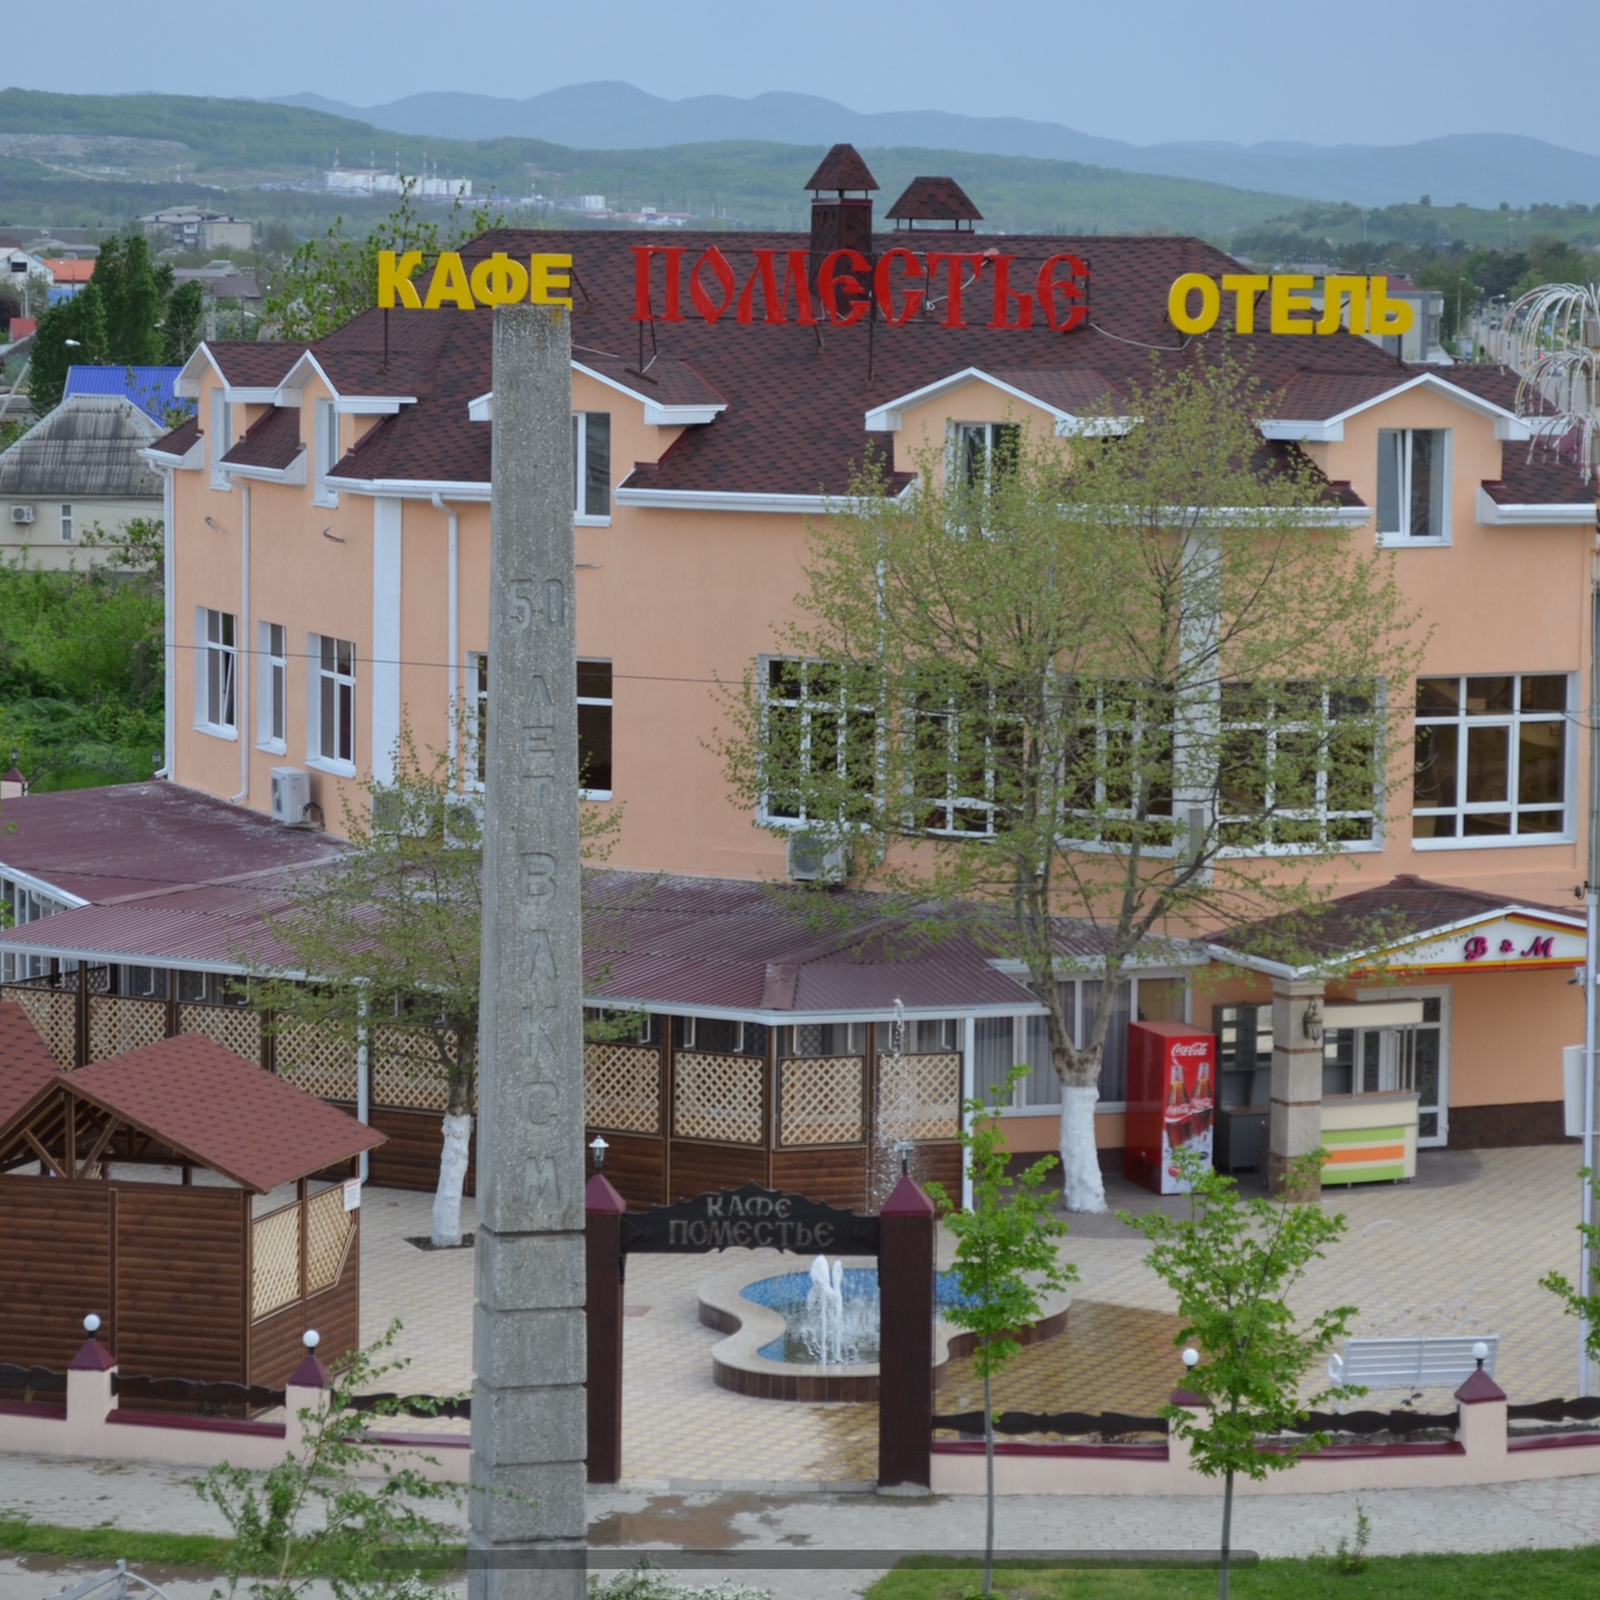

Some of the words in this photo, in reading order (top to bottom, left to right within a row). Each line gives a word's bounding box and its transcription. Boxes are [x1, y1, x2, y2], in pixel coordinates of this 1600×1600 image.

[378, 251, 573, 311] КАФЕ
[629, 244, 1091, 331] ПОМЕСТЬЕ
[1168, 272, 1415, 336] ОТЕЛЬ
[510, 578, 564, 631] 50
[520, 675, 555, 808] ЛЕТ
[668, 1219, 835, 1247] ПОМЕСТЬЕ
[706, 1196, 792, 1218] КАФЕ
